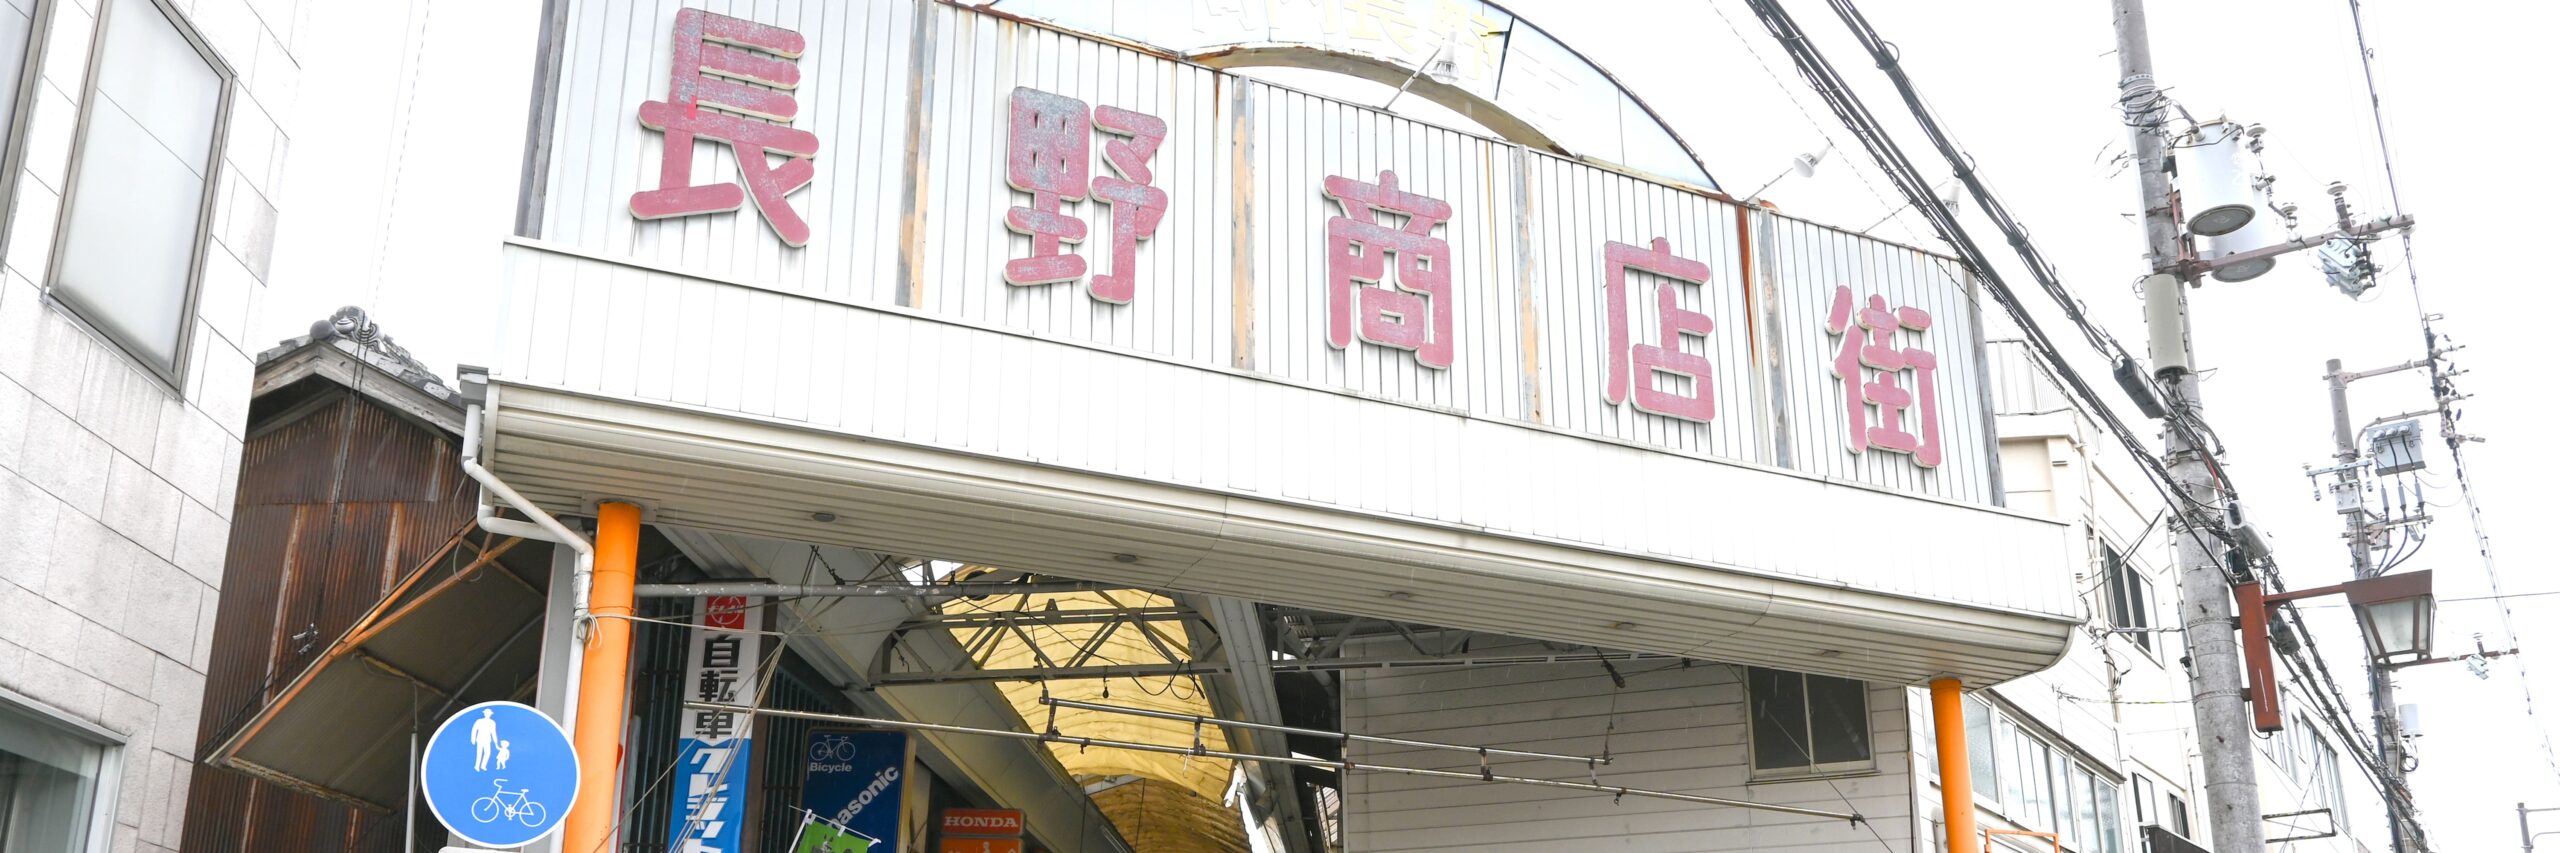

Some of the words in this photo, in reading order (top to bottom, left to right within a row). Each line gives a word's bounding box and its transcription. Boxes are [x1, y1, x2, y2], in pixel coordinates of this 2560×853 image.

[630, 8, 1940, 469] 長野商店街
[695, 634, 742, 739] 自転車
[809, 762, 853, 773] Bicycle
[944, 816, 1019, 827] HONDA
